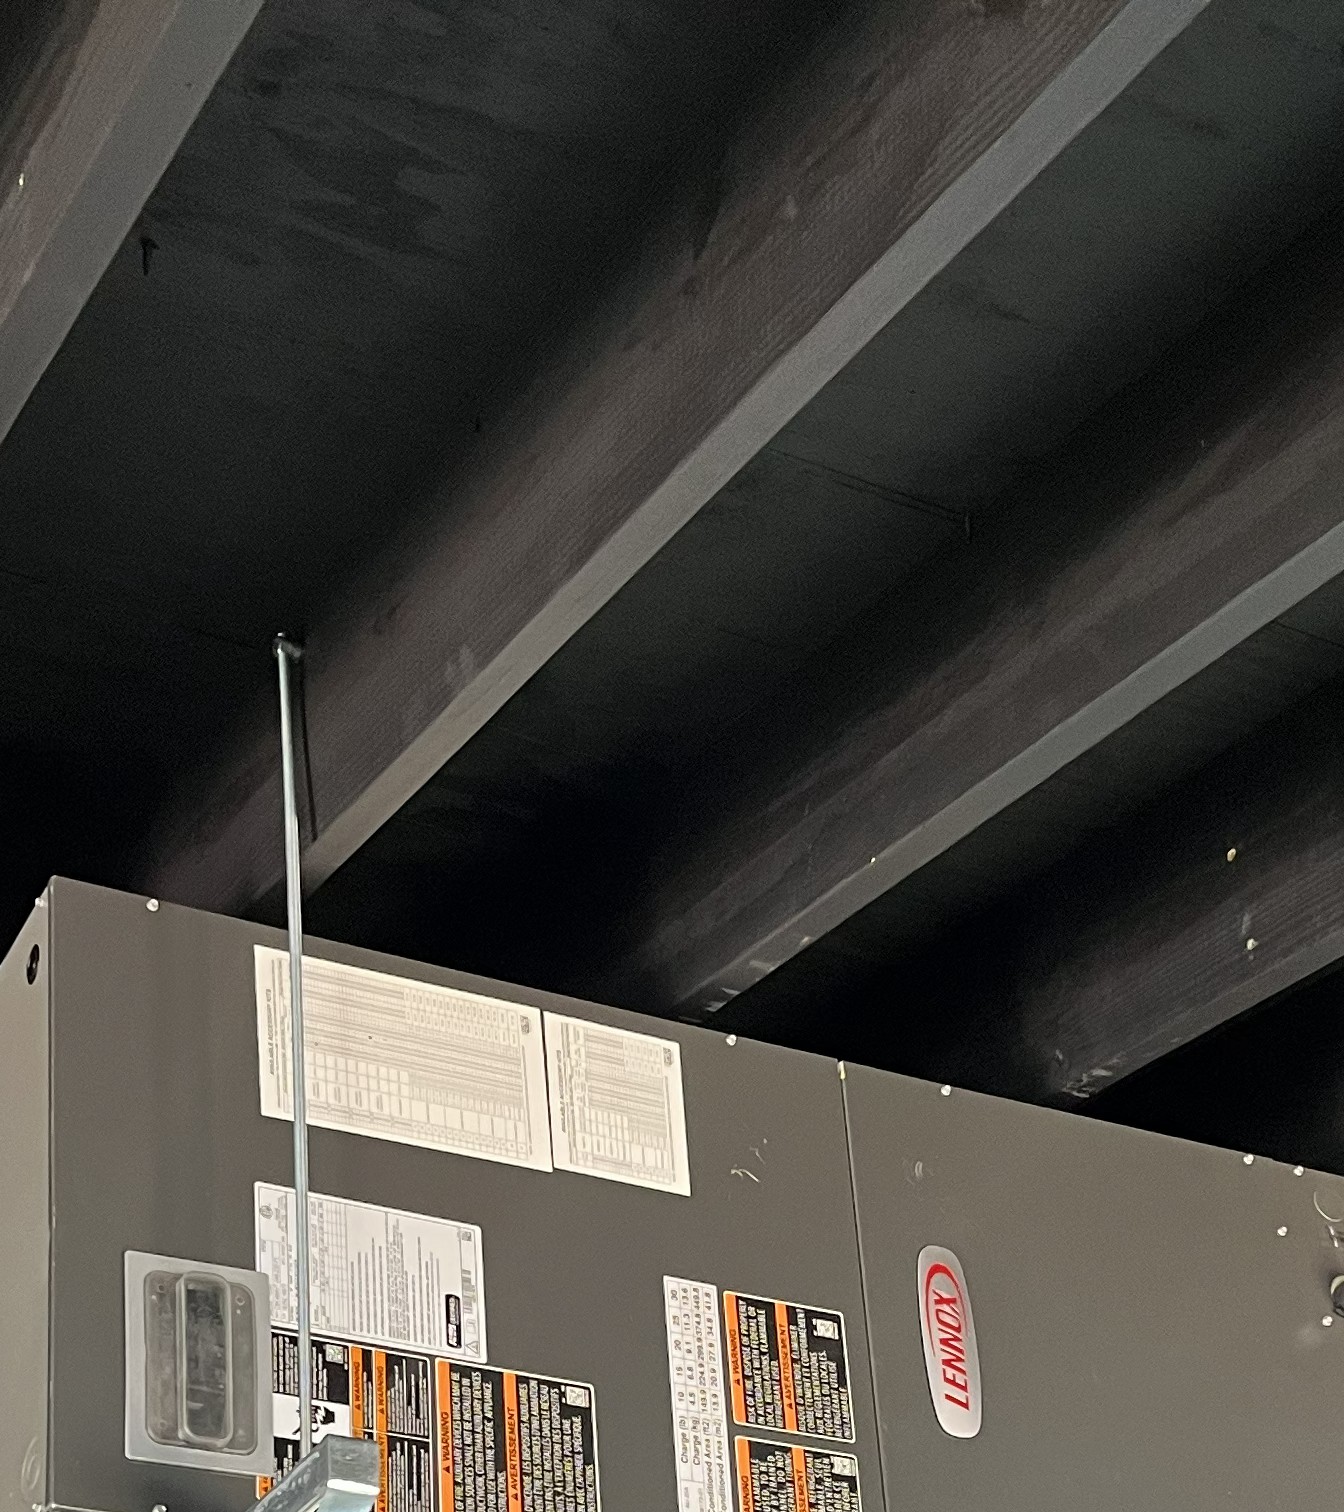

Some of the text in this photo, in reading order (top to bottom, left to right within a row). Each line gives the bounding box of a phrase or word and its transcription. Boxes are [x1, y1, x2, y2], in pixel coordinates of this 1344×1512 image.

[674, 1340, 682, 1351] 20
[730, 1329, 739, 1374] WARNING
[780, 1324, 790, 1400] AVERTISSEMENT
[932, 1288, 970, 1411] LENNOX
[678, 1392, 685, 1402] 10
[441, 1412, 450, 1461] WARNING
[508, 1407, 517, 1491] AVERTISSEMENT
[680, 1432, 690, 1463] Charge
[692, 1435, 702, 1466] Charge
[704, 1438, 712, 1459] Area
